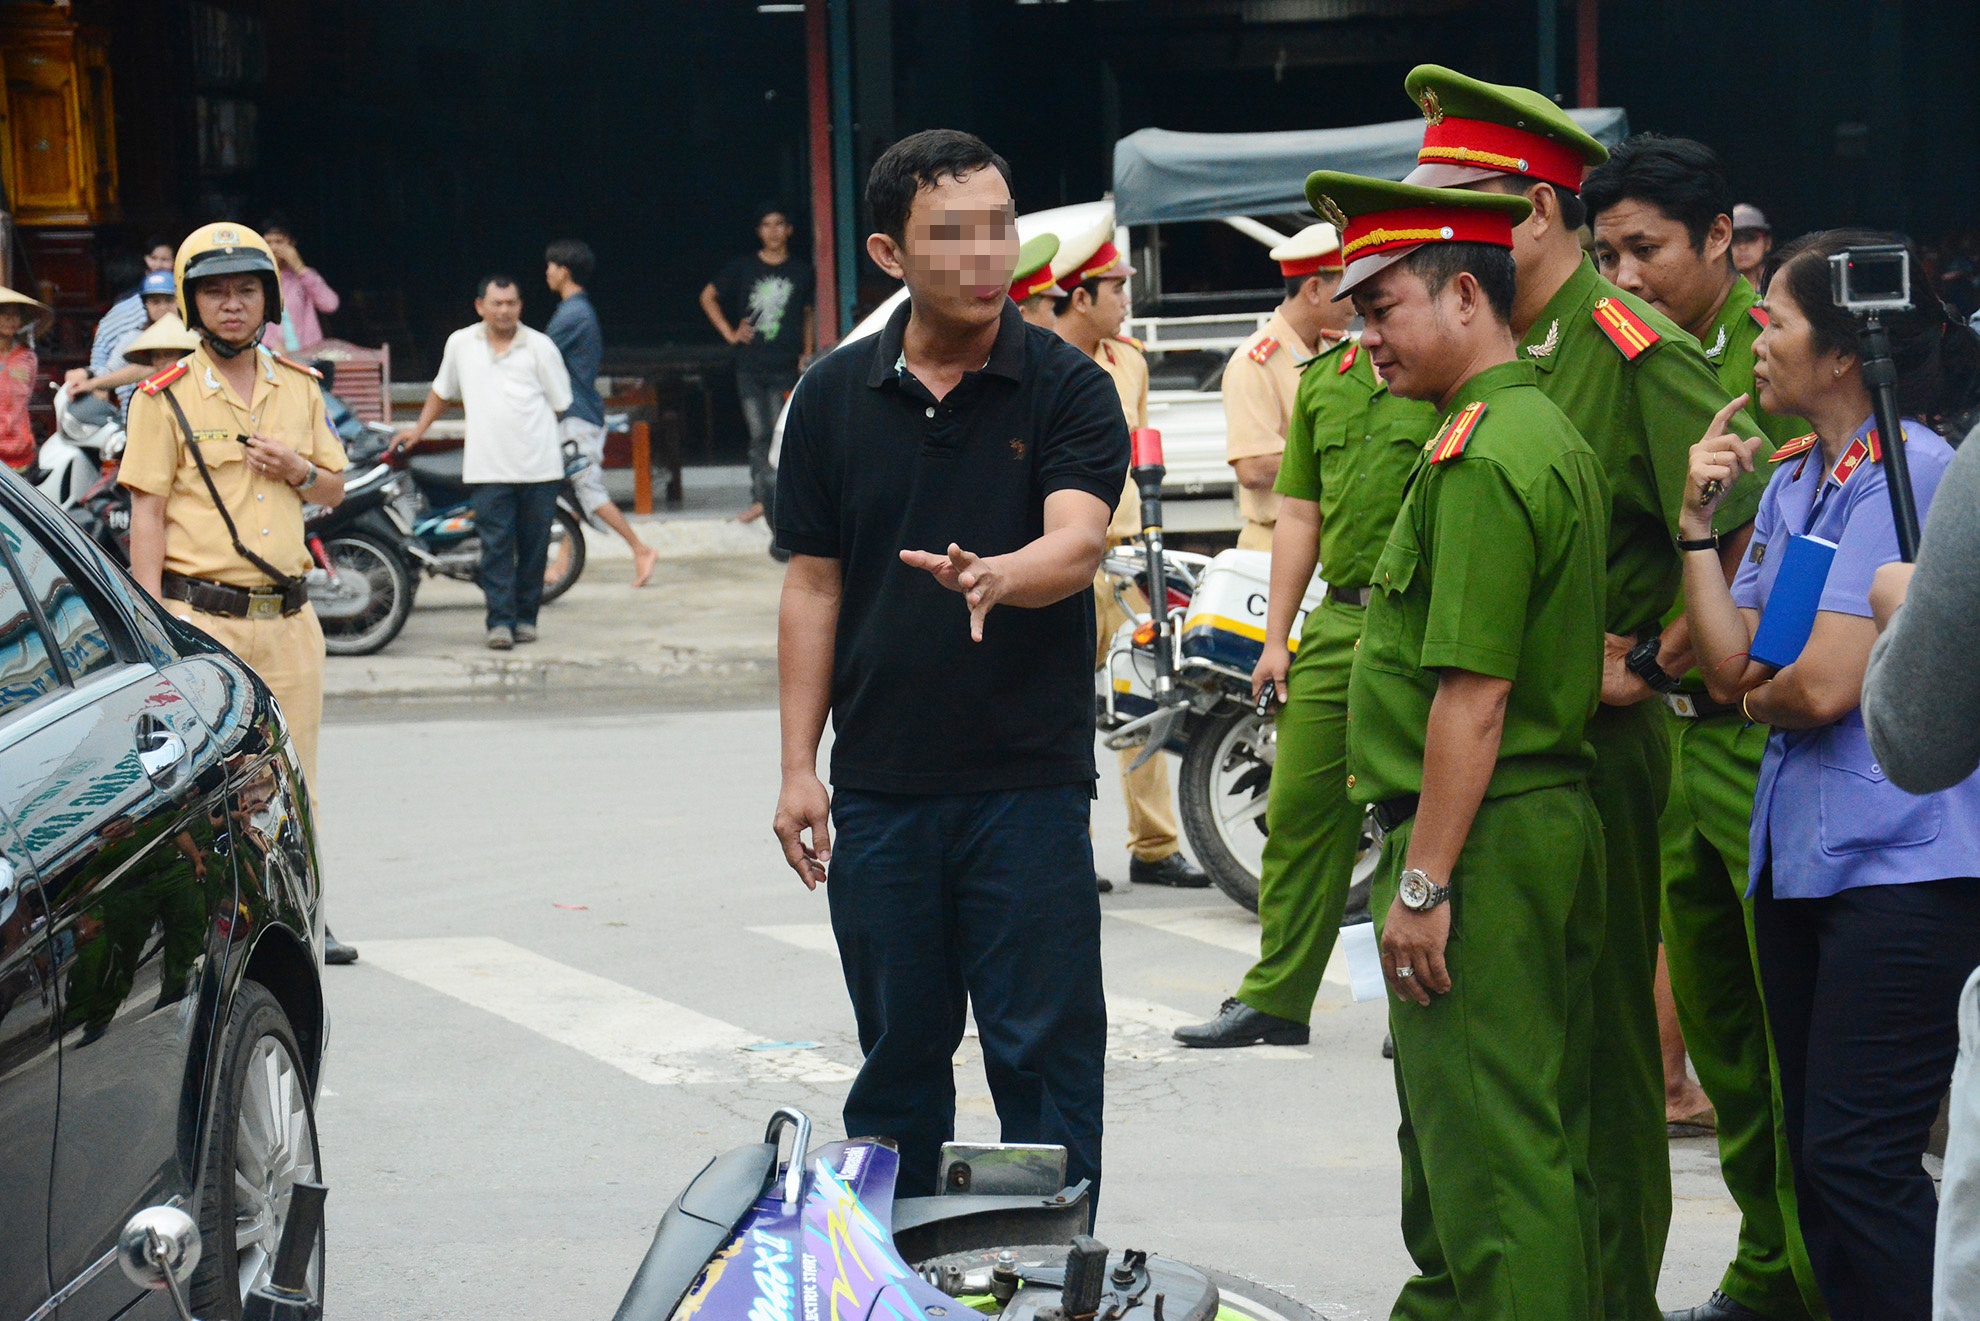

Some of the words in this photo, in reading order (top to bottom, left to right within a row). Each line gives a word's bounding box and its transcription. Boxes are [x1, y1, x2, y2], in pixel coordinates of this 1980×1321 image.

[802, 1252, 817, 1283] START
[981, 1251, 1019, 1262] TYE
[803, 1284, 819, 1321] ECTRIC
